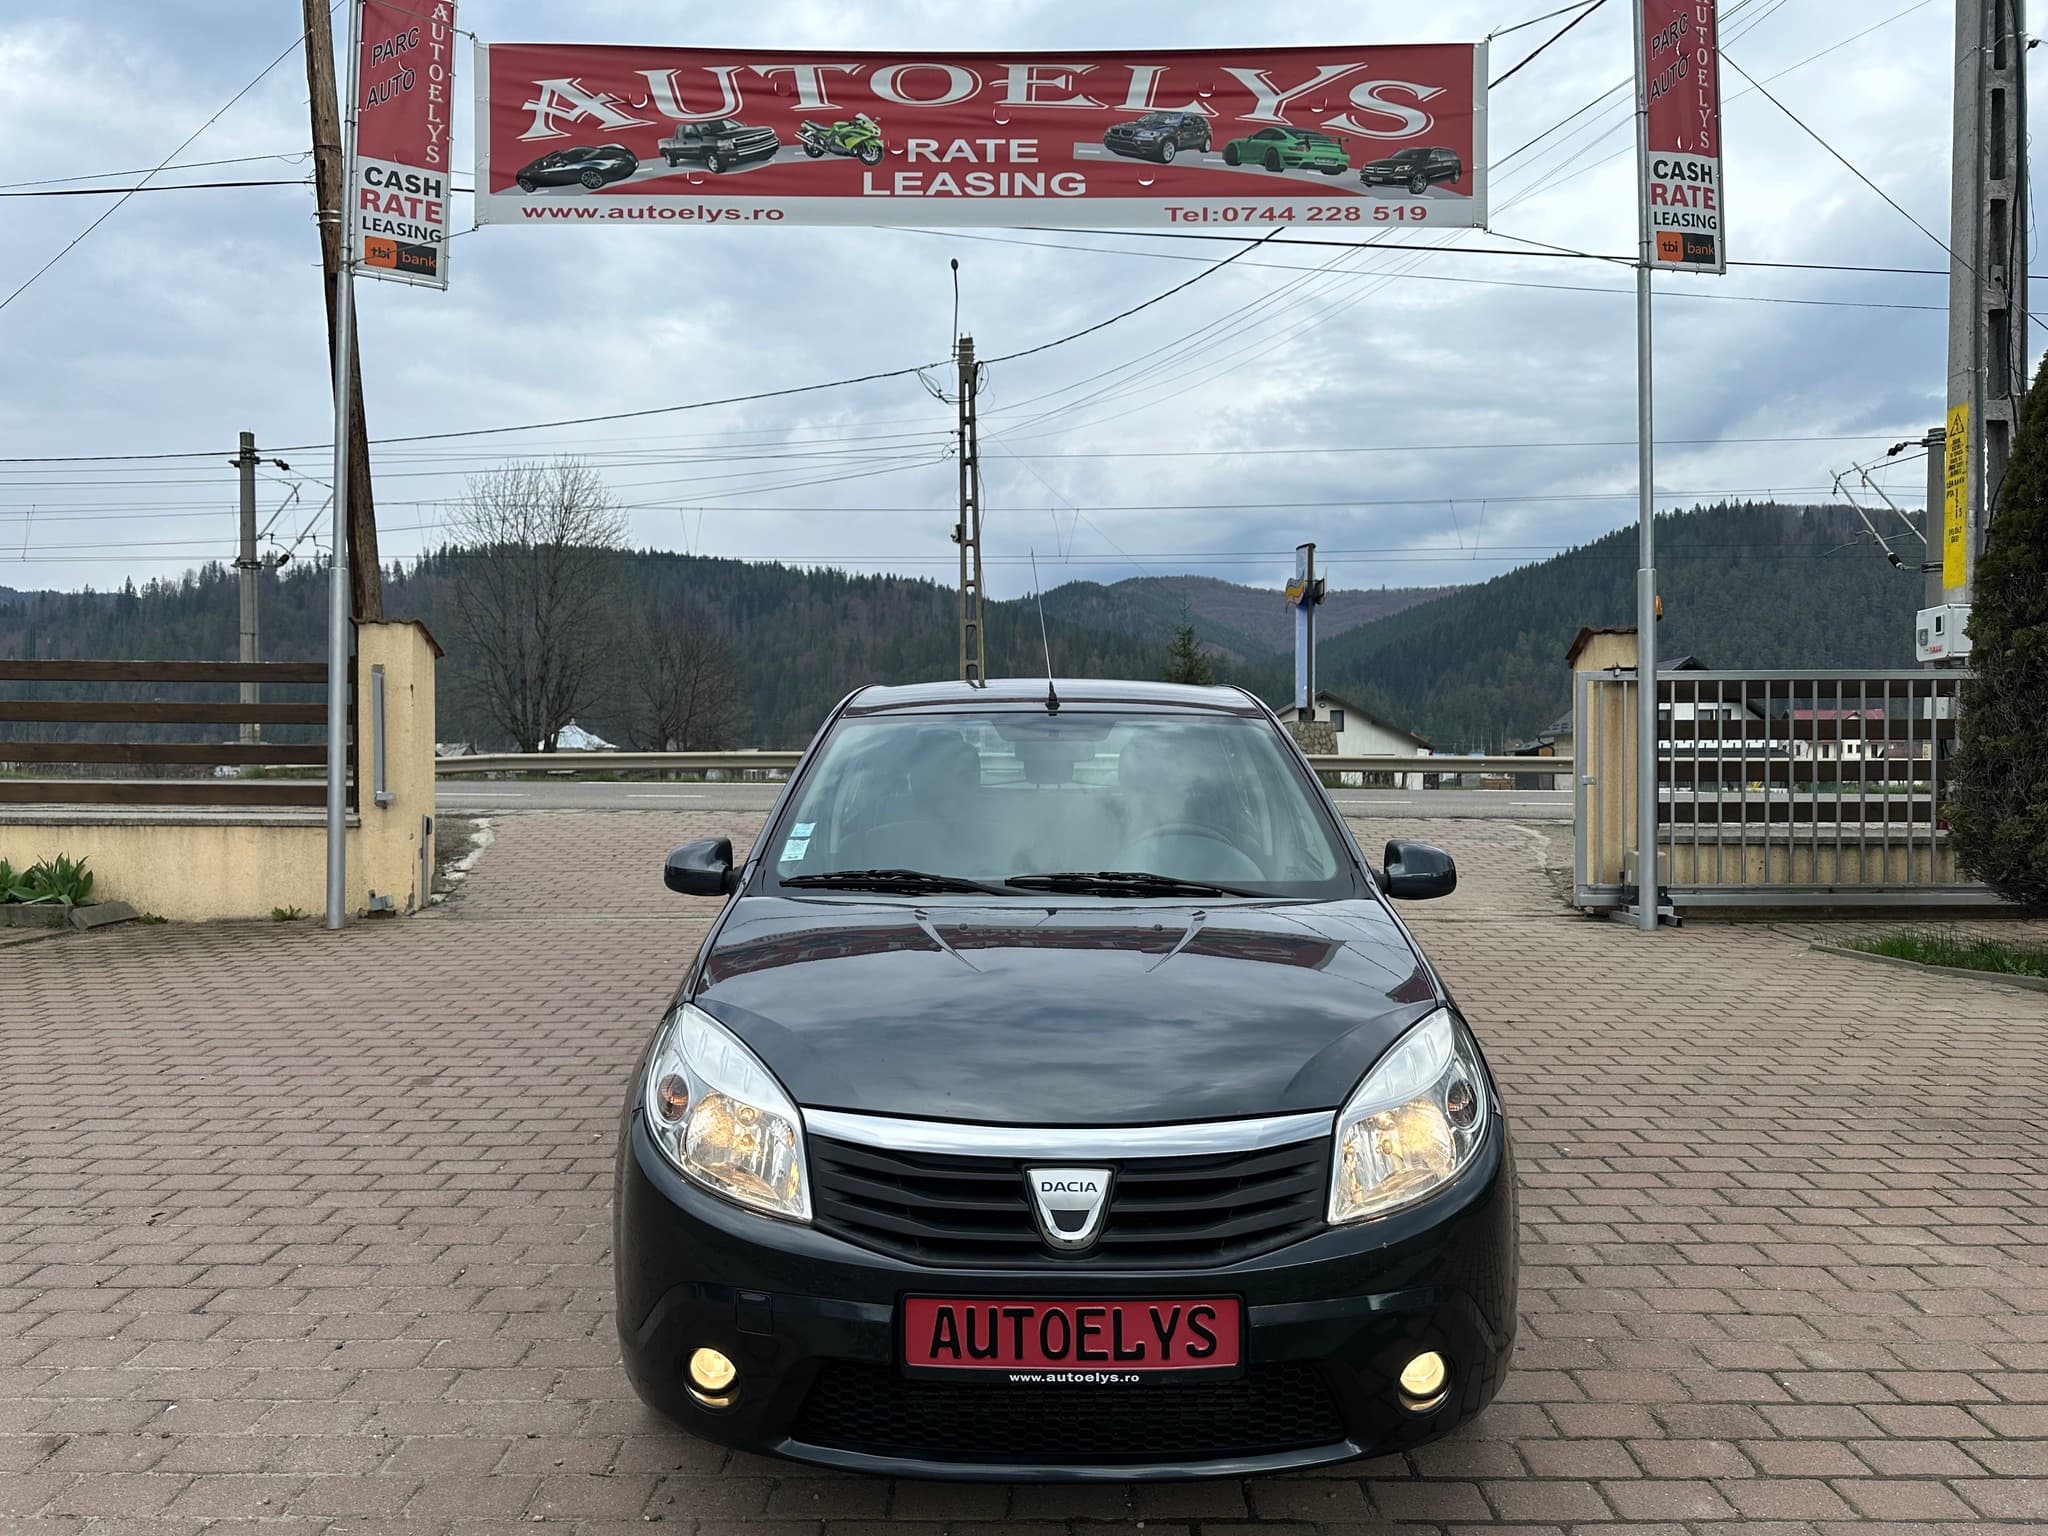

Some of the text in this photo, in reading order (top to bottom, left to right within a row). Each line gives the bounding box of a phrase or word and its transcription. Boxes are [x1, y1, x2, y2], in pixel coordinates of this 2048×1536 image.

[371, 27, 420, 68] PARC
[1652, 12, 1689, 60] PARC
[426, 3, 449, 164] AUTOELYS
[1650, 56, 1690, 104] AUTO
[1695, 0, 1710, 149] UTOELYS
[365, 68, 417, 111] AUTO
[516, 62, 1446, 142] AUTOELYS
[907, 138, 1039, 163] RATE
[364, 166, 441, 199] CASH
[863, 171, 1086, 196] LEASING
[1653, 159, 1713, 184] CASH
[360, 188, 443, 224] RATE
[1651, 183, 1716, 210] RATE
[521, 203, 785, 223] www.autoelys.ro
[1306, 206, 1361, 222] 228
[1373, 206, 1427, 221] 519
[1654, 211, 1717, 229] LEASING
[362, 216, 442, 243] LEASING
[402, 251, 436, 268] bank
[1663, 241, 1714, 256] tbi bank
[1041, 1181, 1098, 1193] DACIA
[929, 1305, 1217, 1361] AUTOELYS
[1009, 1373, 1140, 1384] www.autoelys.ro
